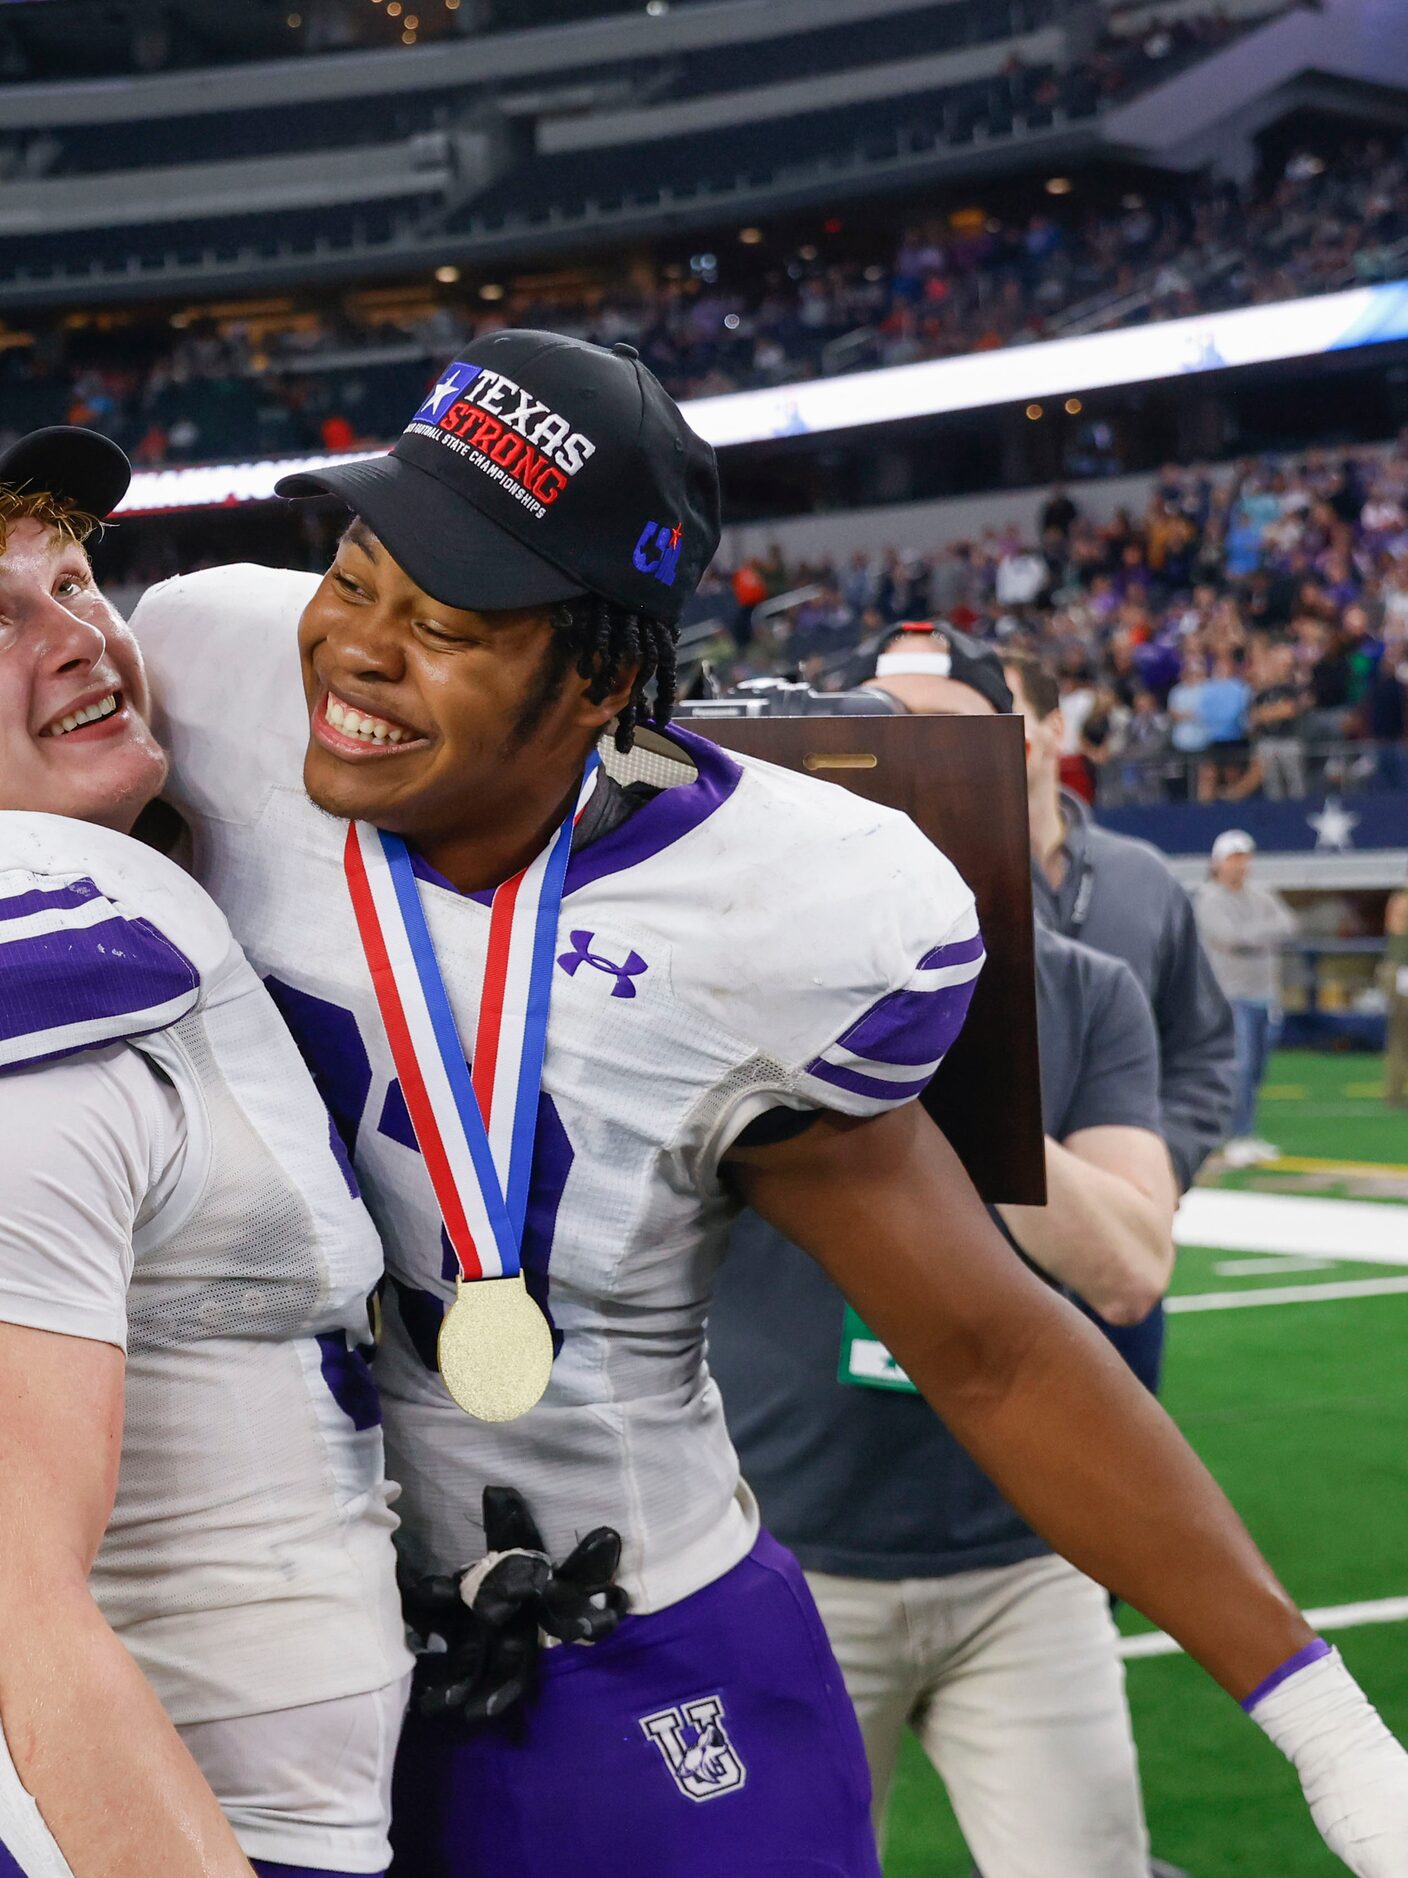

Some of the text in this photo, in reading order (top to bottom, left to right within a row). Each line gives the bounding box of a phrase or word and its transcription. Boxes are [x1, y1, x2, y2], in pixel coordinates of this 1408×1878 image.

[440, 401, 568, 505] STRONG
[464, 369, 596, 476] TEXAS
[441, 433, 471, 456] STATE
[468, 451, 547, 519] CHAMPIONSHIPS
